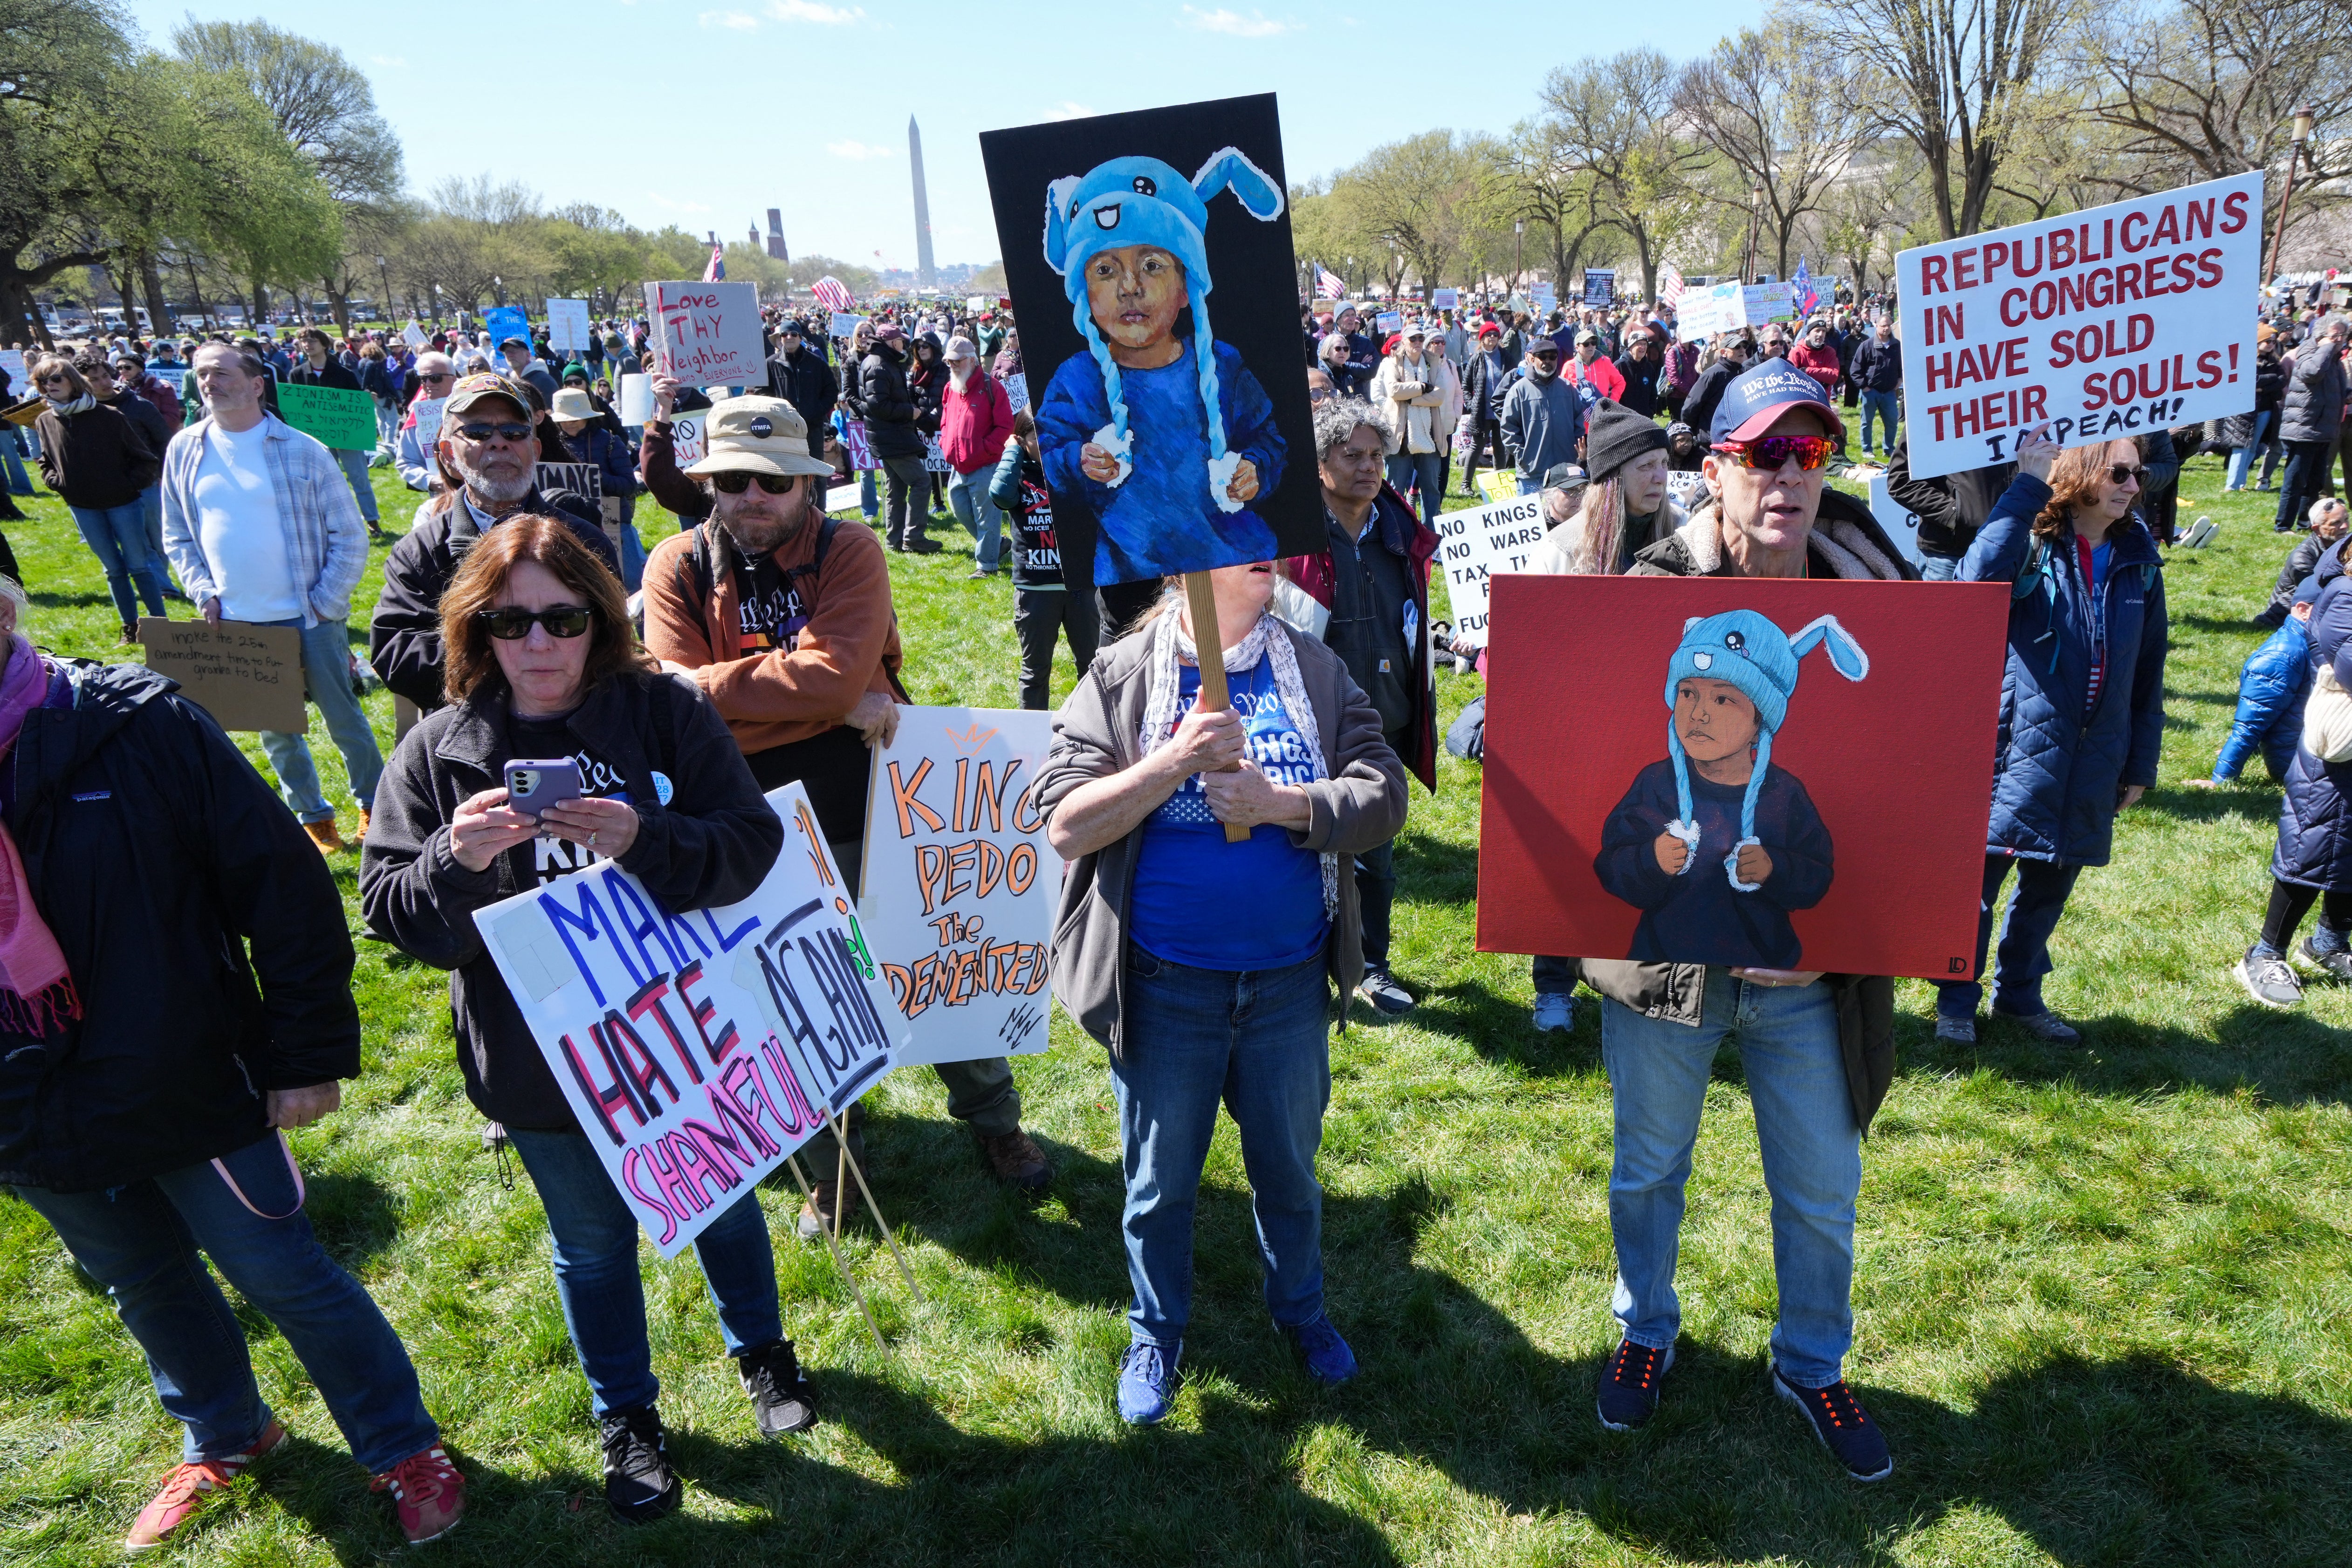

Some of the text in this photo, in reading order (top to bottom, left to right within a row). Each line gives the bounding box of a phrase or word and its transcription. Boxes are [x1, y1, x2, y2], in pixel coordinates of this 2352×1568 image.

[1921, 192, 2249, 295] REPUBLICANS
[1769, 285, 1778, 293] RED
[1779, 284, 1790, 292] LINE
[1924, 248, 2223, 346] IN CONGRESS
[658, 286, 720, 314] Love
[1678, 308, 1698, 316] WHALE
[1700, 318, 1717, 328] ocean!
[495, 325, 522, 334] PEOPLE
[668, 314, 721, 346] THY
[1379, 320, 1399, 329] COMPLICIT
[662, 345, 737, 374] Neighbor
[1926, 313, 2154, 392] HAVE SOLD
[675, 366, 742, 384] eans EVERYONE
[1001, 376, 1019, 390] ACH
[1741, 372, 1818, 397] We the People
[283, 386, 361, 404] ZIONISM IS
[1746, 390, 1767, 404] HAVE
[1789, 386, 1818, 400] ENOUGH
[1927, 343, 2239, 441] THEIR SOULS!
[302, 400, 371, 415] ANTISEMITIC
[850, 428, 871, 450] N
[1985, 397, 2185, 462] IMPEACH!
[1669, 472, 1689, 480] YOU
[1486, 488, 1502, 499] To
[1028, 515, 1053, 525] MAR
[1440, 503, 1537, 538] NO KINGS
[1446, 527, 1542, 561] NO WARS
[1452, 563, 1489, 584] TAX
[216, 633, 232, 643] the
[154, 646, 221, 661] amendment
[226, 651, 250, 665] time
[251, 656, 262, 665] to
[235, 667, 279, 684] to bed
[1263, 765, 1316, 787] RIC
[914, 839, 1038, 917] PEDO
[928, 911, 984, 947] The
[881, 937, 1049, 1020] DEMENTED
[754, 927, 891, 1097] AGAIN
[558, 959, 741, 1148] HATE
